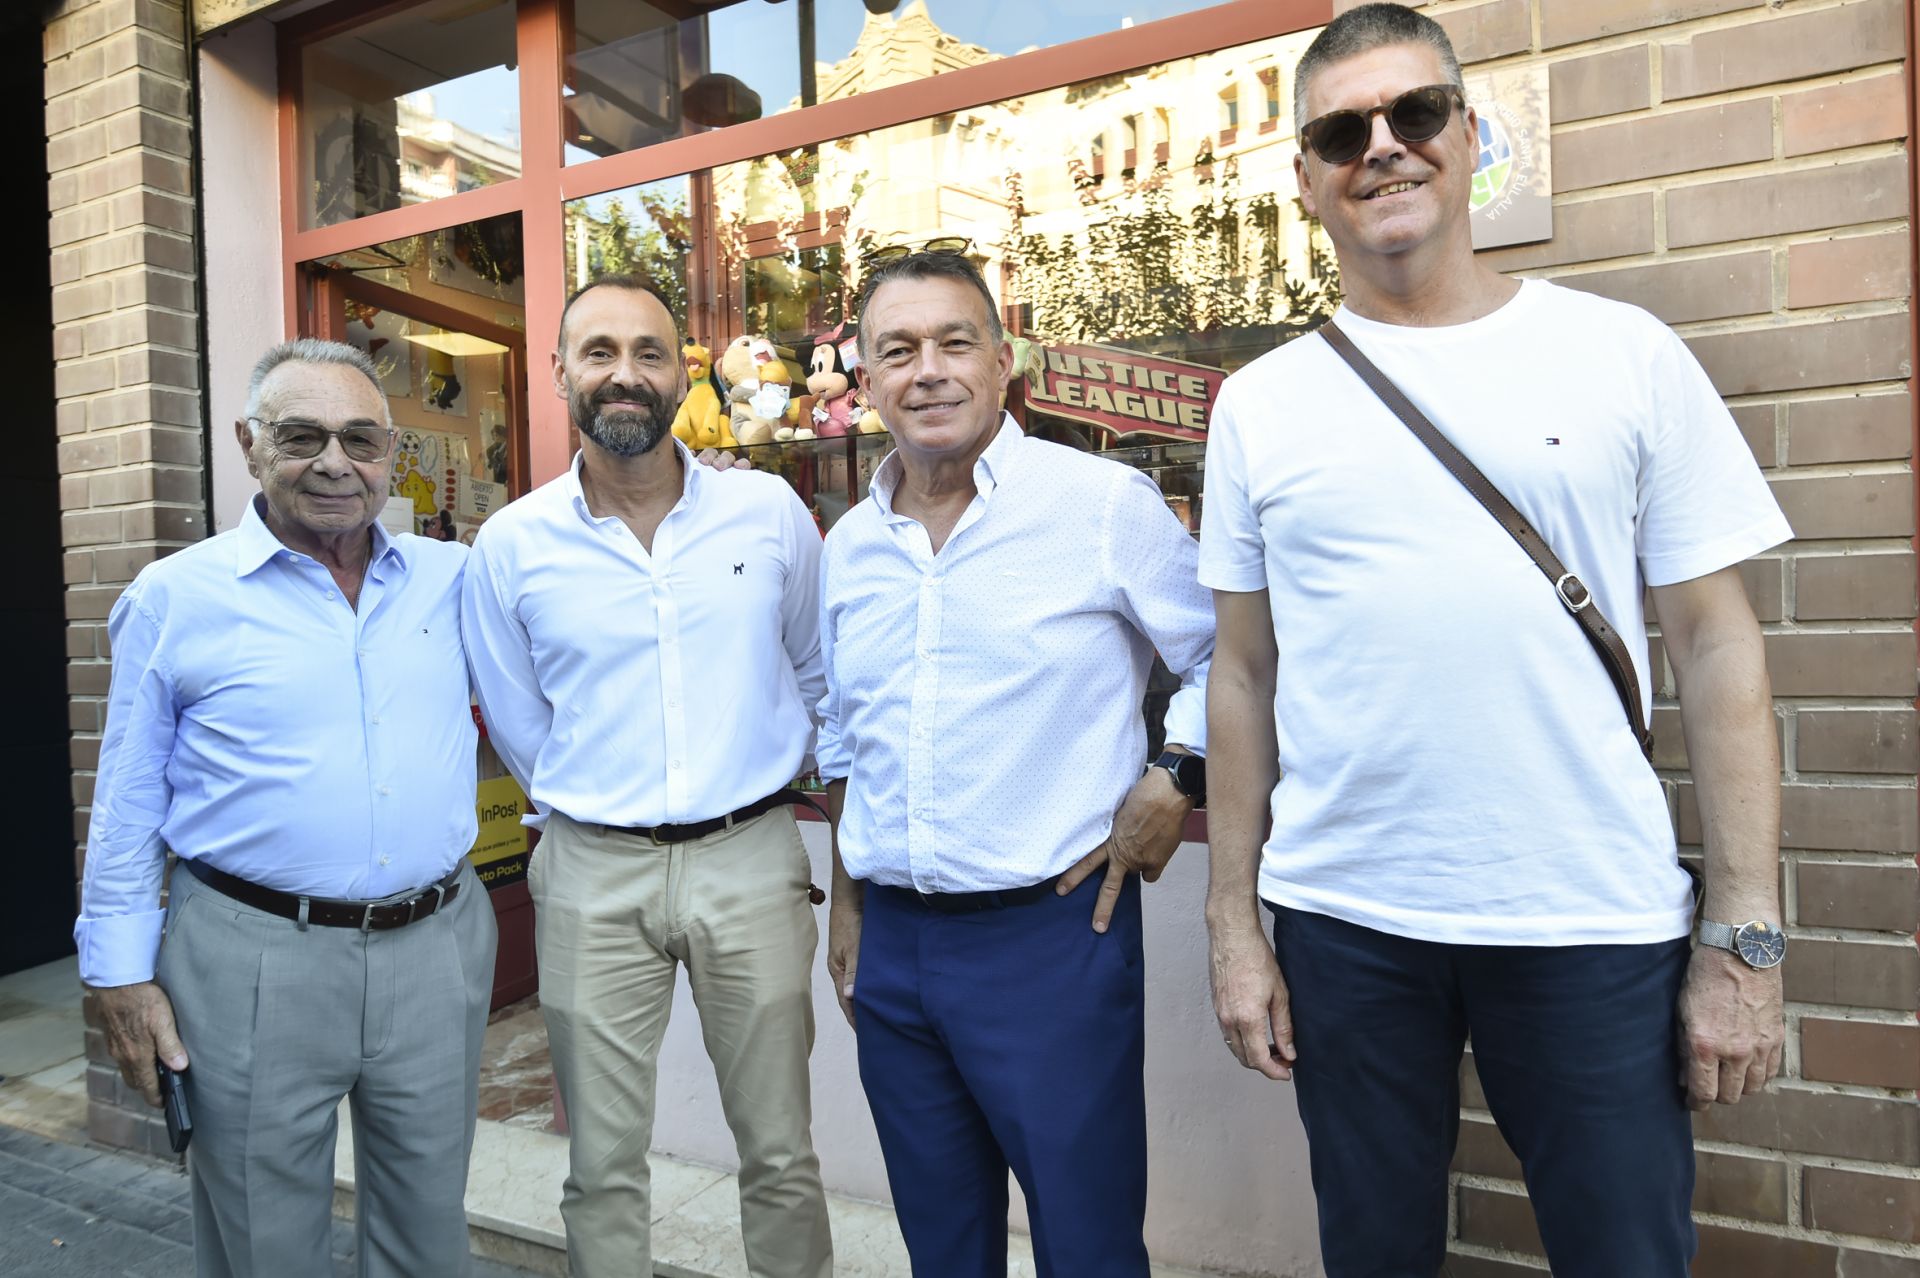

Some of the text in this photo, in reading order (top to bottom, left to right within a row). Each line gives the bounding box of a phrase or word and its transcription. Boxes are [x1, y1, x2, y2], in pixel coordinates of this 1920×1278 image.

[1517, 128, 1532, 170] SANTA
[1486, 174, 1528, 220] EULALIA
[1031, 370, 1208, 430] LEAGUE
[474, 492, 489, 503] OPEN
[481, 800, 519, 823] InPost
[479, 860, 522, 882] nto Pack
